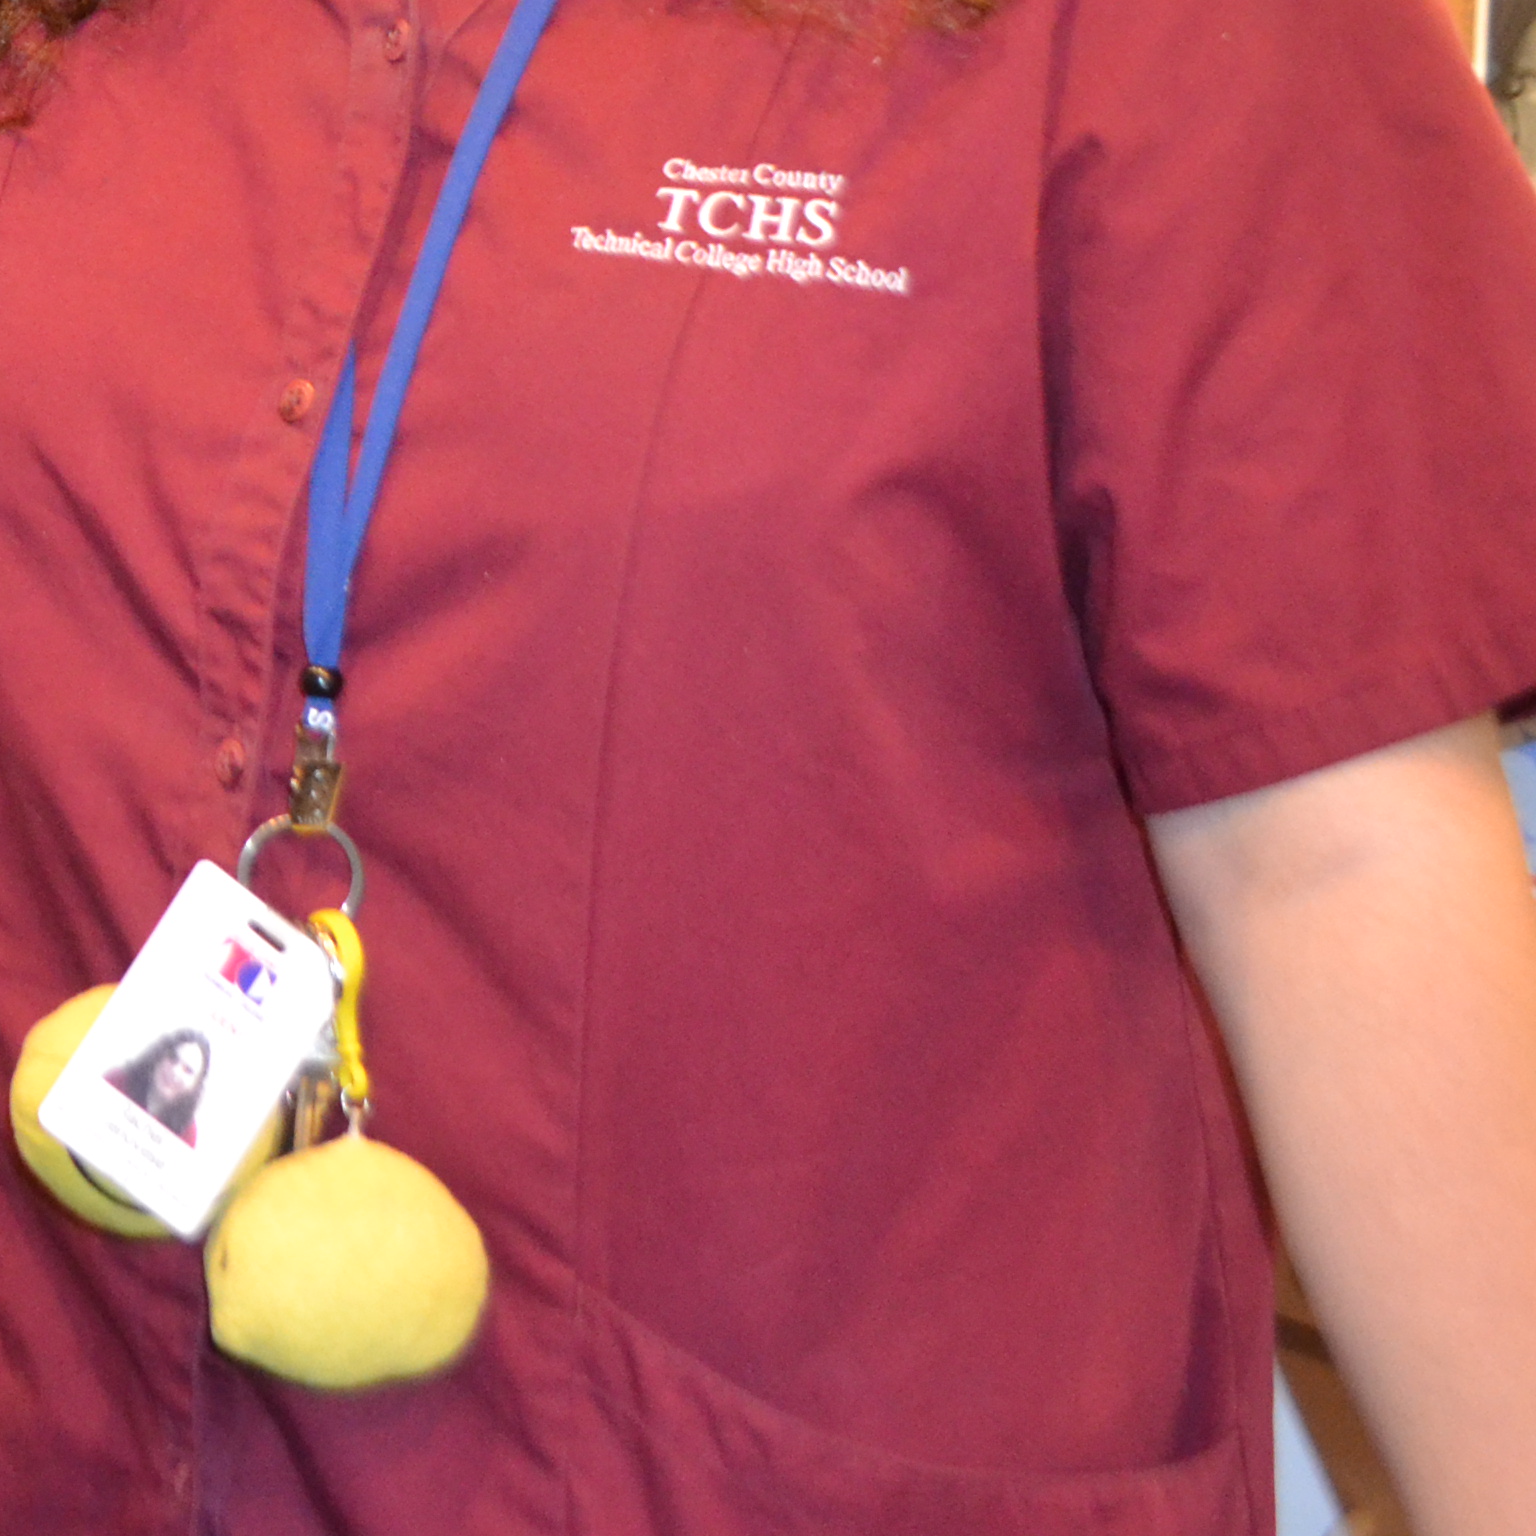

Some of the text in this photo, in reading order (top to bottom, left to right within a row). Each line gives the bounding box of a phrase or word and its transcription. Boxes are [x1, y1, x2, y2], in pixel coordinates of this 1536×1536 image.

[661, 157, 845, 195] Chester County
[655, 186, 842, 247] TCHS
[570, 226, 911, 294] Technical College High School
